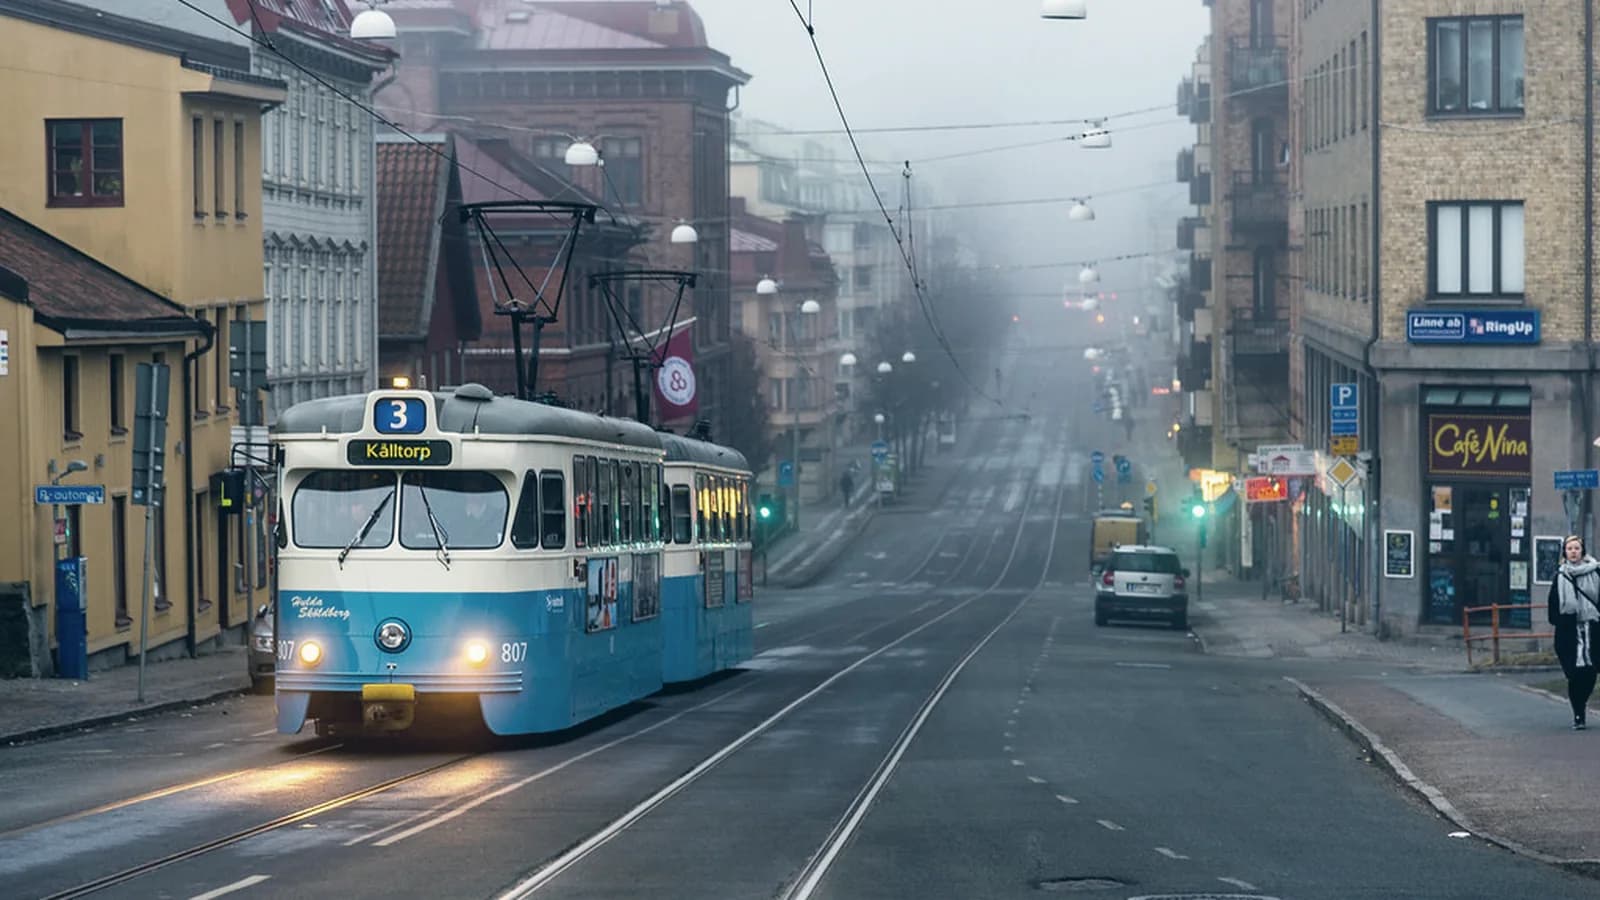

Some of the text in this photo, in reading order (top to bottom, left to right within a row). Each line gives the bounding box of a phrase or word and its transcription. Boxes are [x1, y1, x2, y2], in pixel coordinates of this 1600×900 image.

[1414, 317, 1461, 328] Linné ab
[1485, 321, 1533, 335] RingUp
[1339, 386, 1352, 406] P
[390, 400, 408, 430] 3
[366, 442, 432, 462] Kålltorp
[1434, 423, 1528, 467] Café Nina
[290, 596, 323, 608] Hulda
[501, 642, 527, 663] 807
